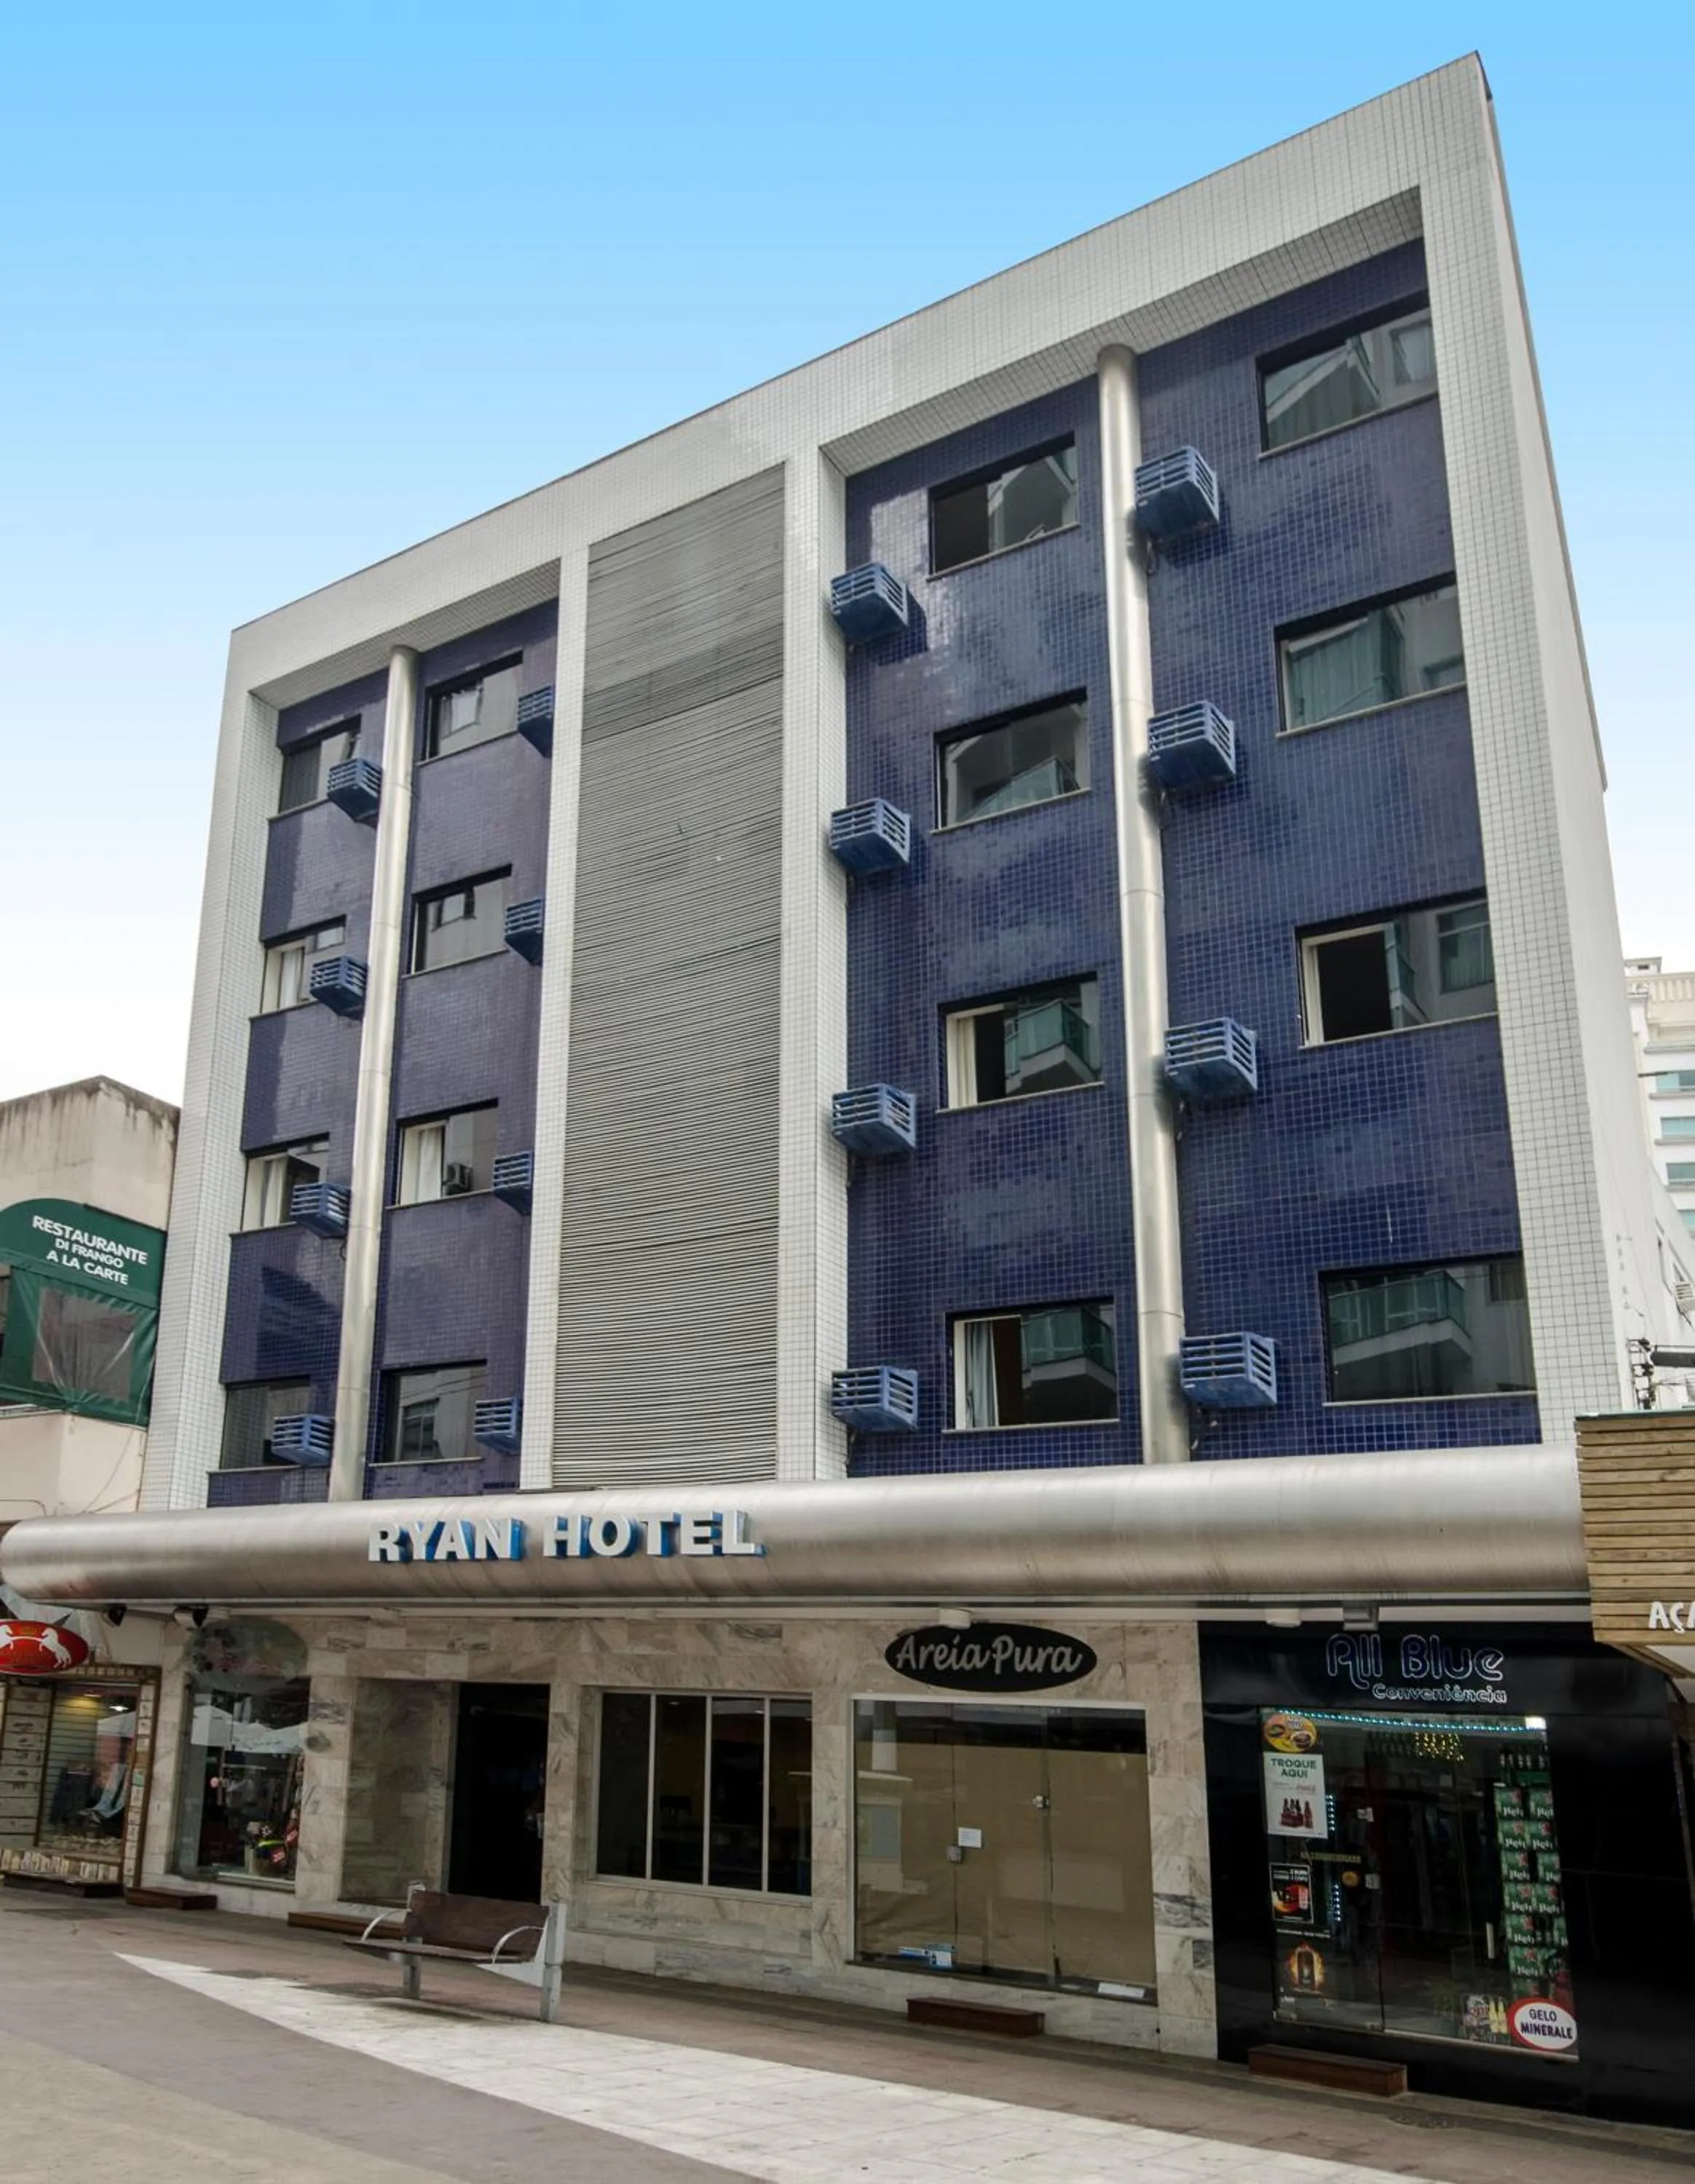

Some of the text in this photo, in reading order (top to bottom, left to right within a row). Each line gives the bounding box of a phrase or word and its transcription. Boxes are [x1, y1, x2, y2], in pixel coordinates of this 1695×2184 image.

[32, 1215, 148, 1265] RESTAURANTE
[55, 1238, 124, 1268] DI FRANGO
[46, 1250, 129, 1285] A LA CARTE
[368, 1511, 764, 1562] RYAN HOTEL
[896, 1634, 1083, 1674] Areia Pura
[1326, 1633, 1504, 1689] All Blue
[1372, 1682, 1507, 1704] Conveniência
[1271, 1758, 1316, 1770] TROQUE
[1281, 1768, 1308, 1779] AQUI
[1529, 2009, 1557, 2022] GELO
[1520, 2022, 1573, 2040] MINERALE
